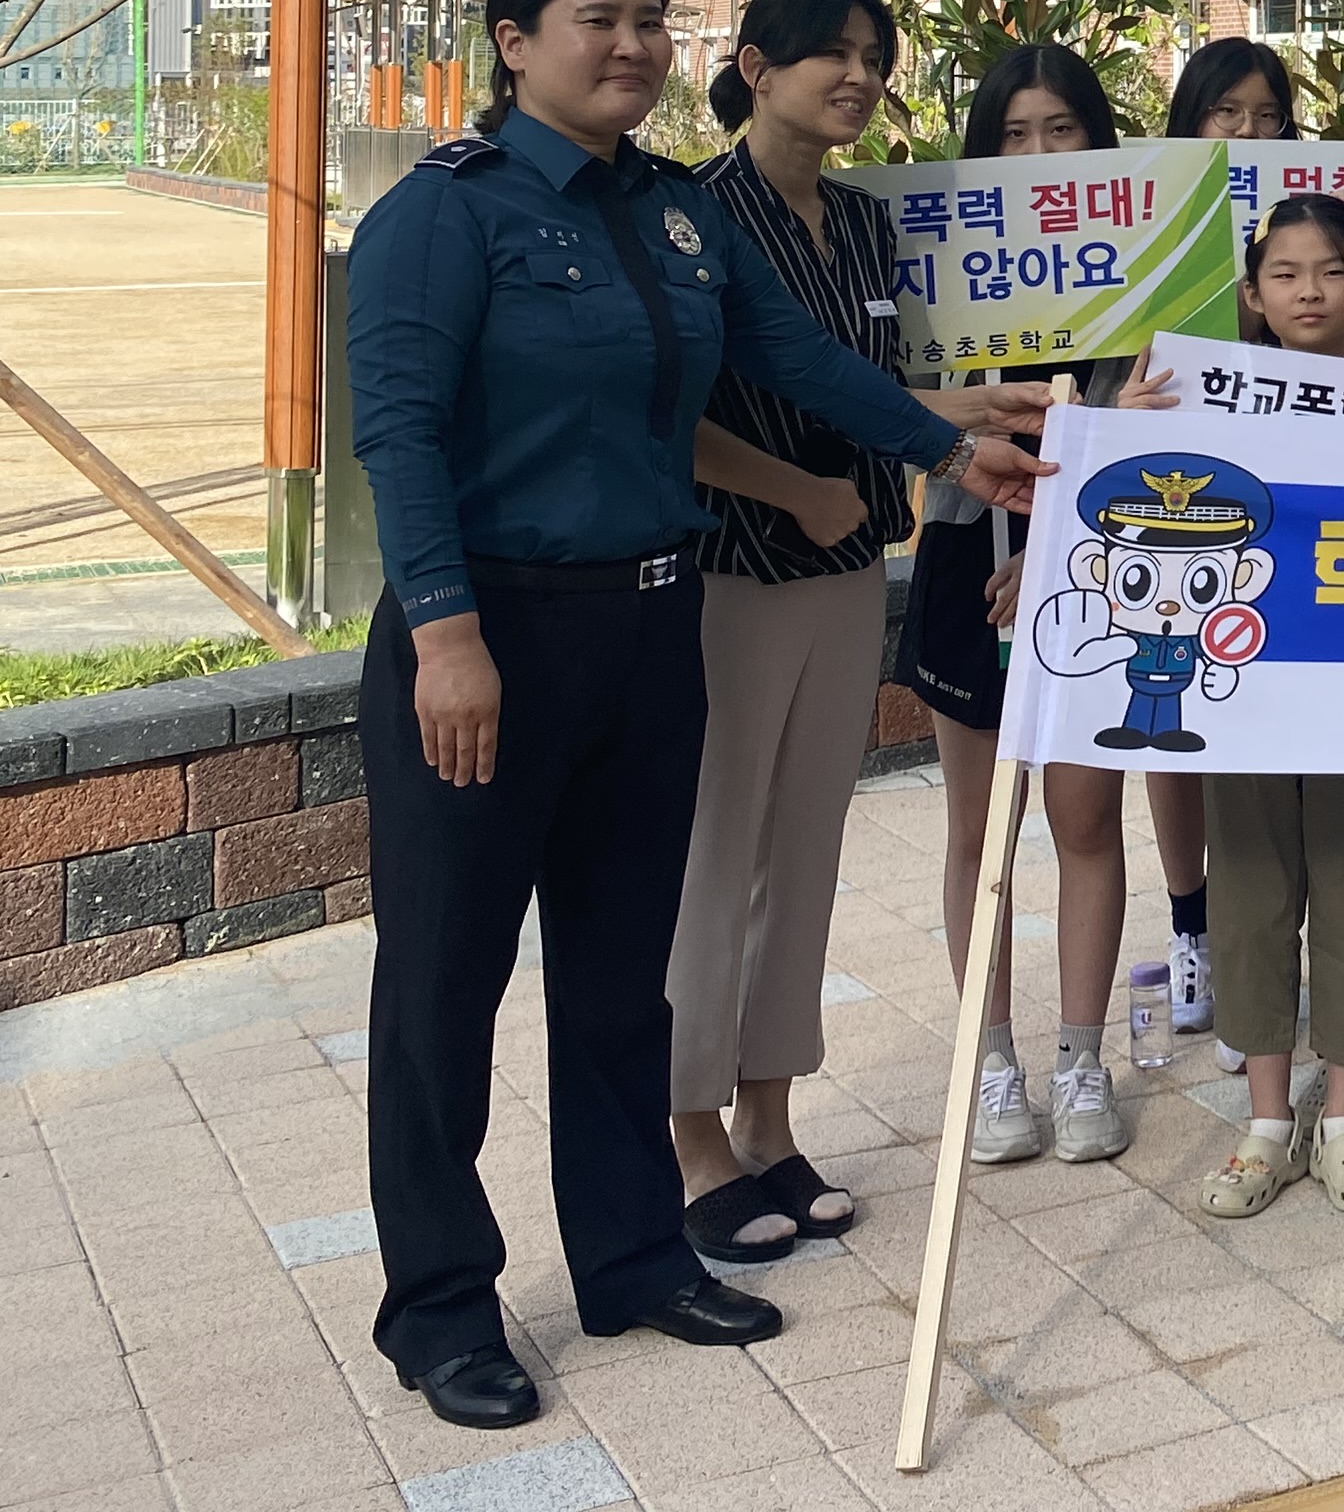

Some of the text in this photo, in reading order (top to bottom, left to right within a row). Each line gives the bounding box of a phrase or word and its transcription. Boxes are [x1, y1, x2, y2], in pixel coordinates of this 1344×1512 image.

[883, 176, 1155, 243] 폭력 절대!
[962, 241, 1125, 301] 않아요
[896, 328, 1075, 365] 사송초등학교
